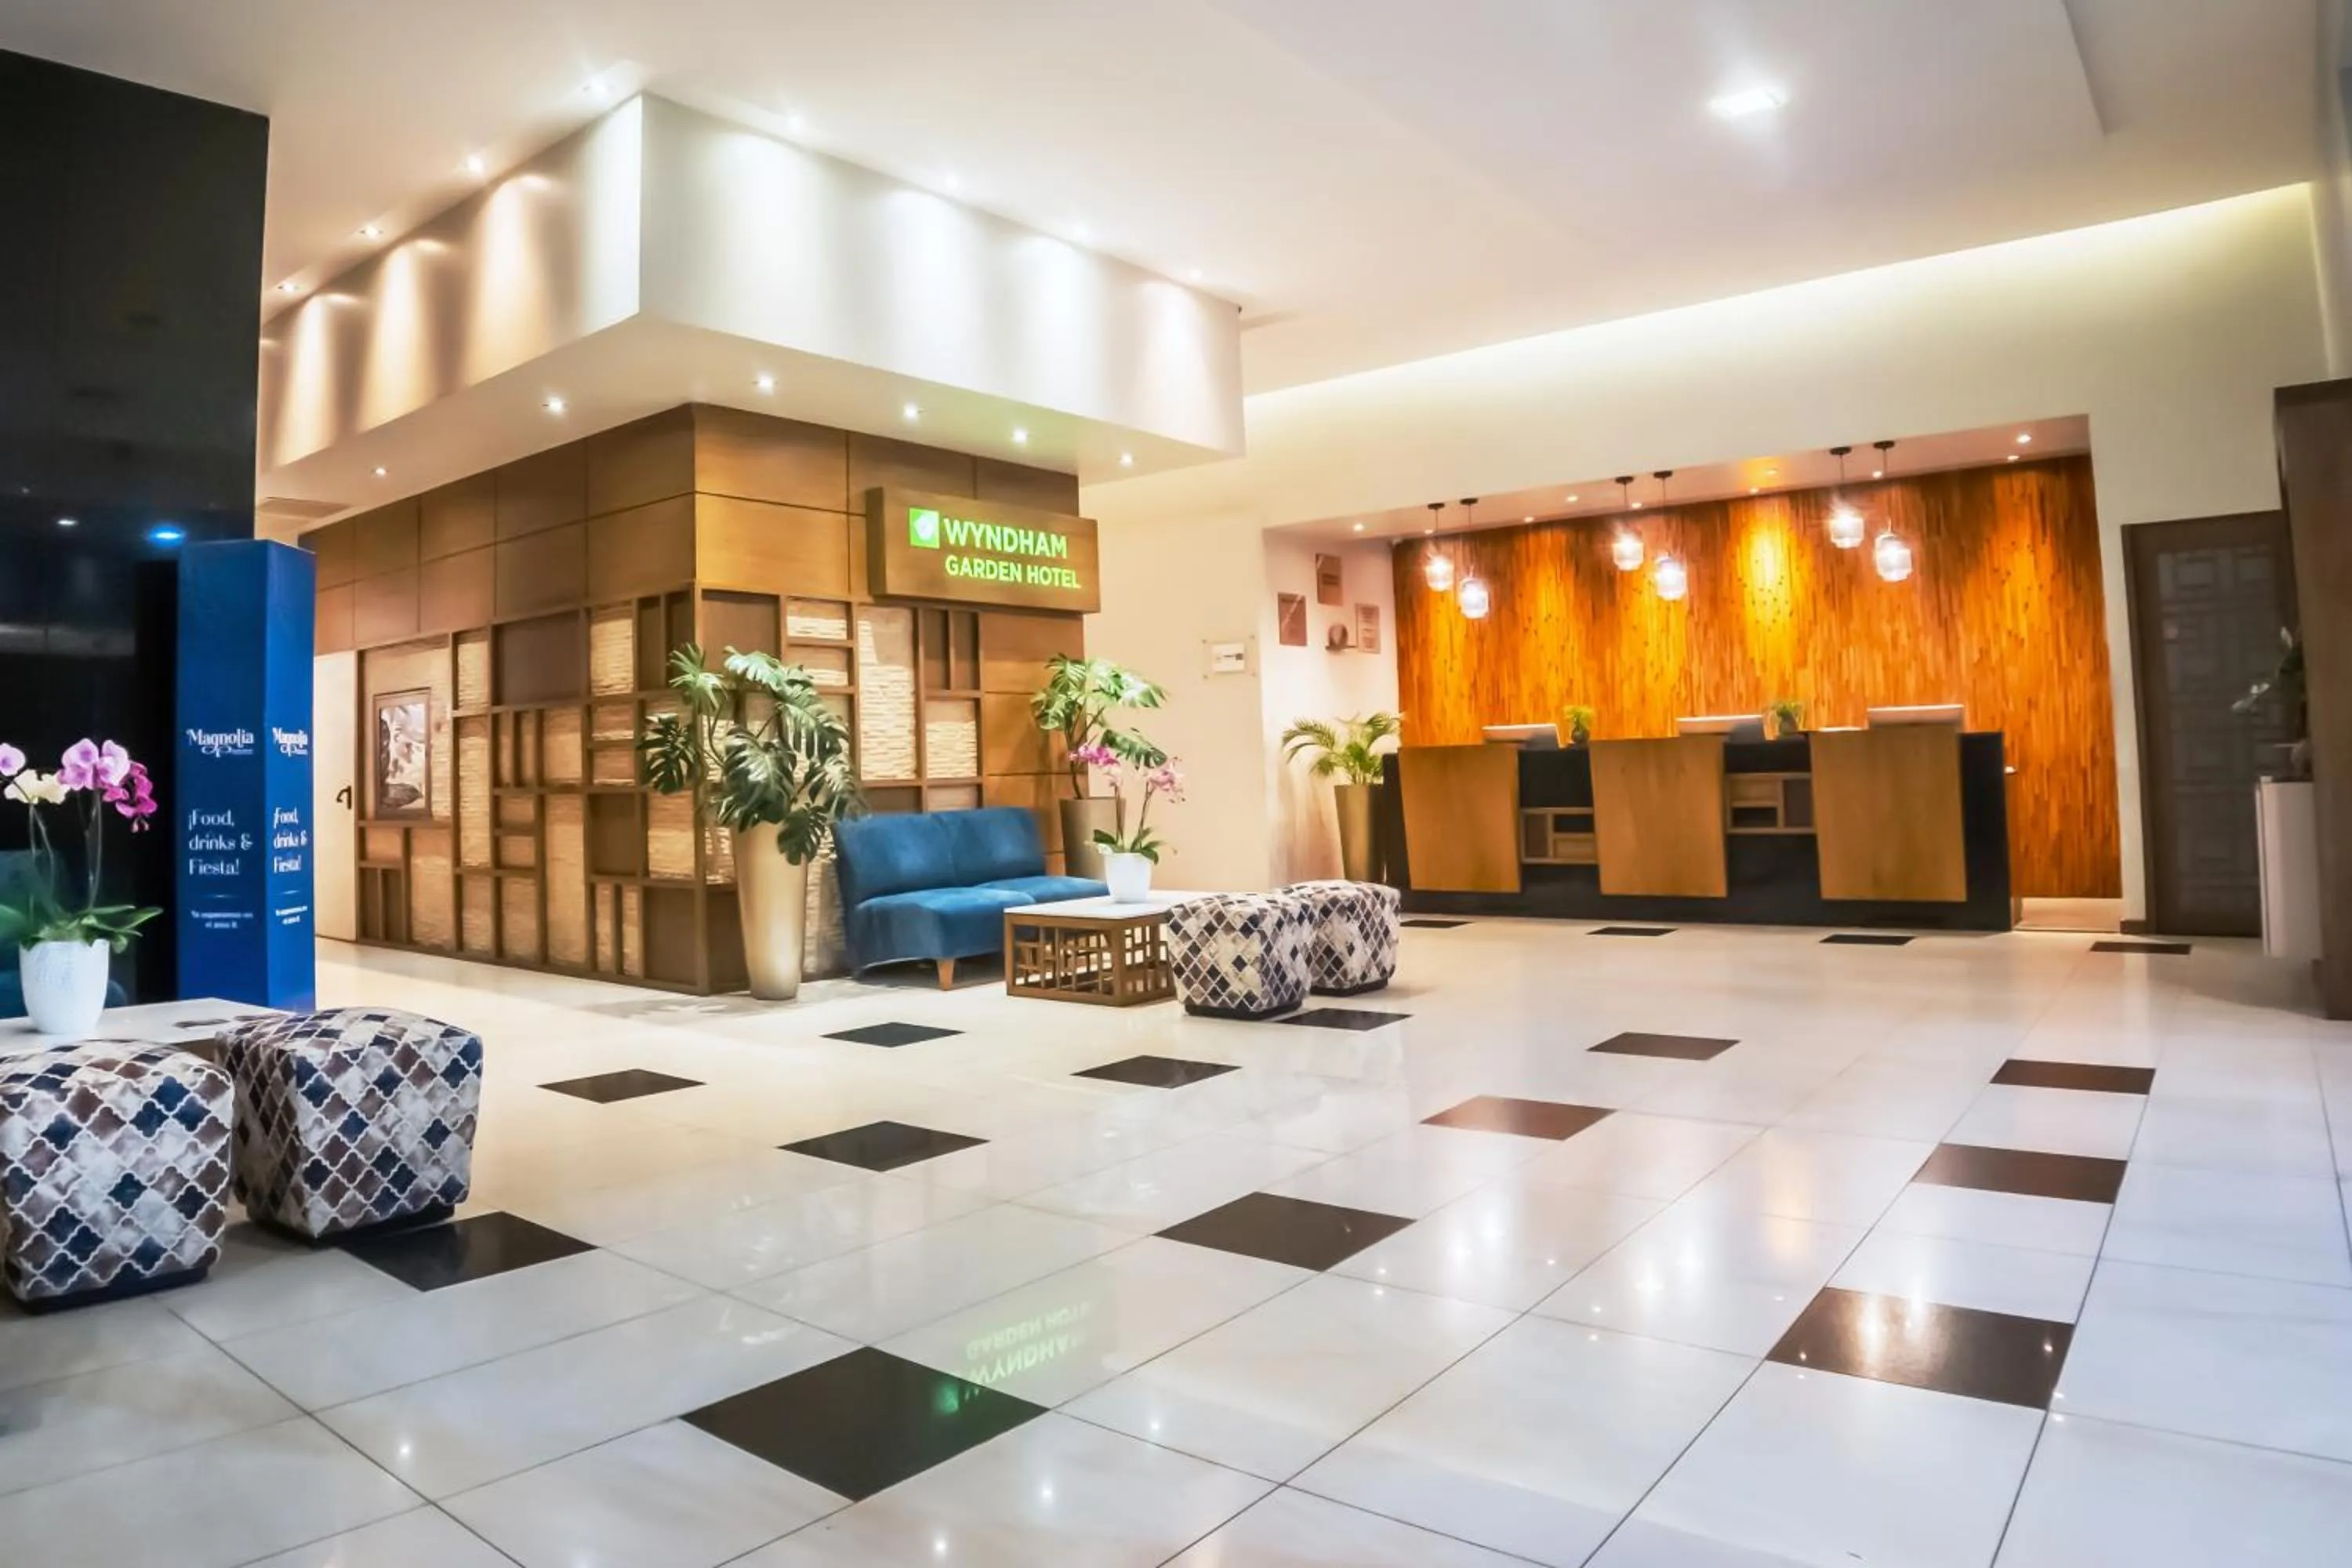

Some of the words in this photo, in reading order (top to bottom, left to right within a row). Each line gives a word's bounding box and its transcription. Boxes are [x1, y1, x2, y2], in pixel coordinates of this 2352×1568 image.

[943, 517, 1068, 559] WYNDHAM
[945, 554, 1022, 583] GARDEN
[1026, 564, 1081, 589] HOTEL
[186, 728, 255, 758] Magnolia
[188, 808, 235, 831] ¡Food,
[188, 833, 236, 851] drinks
[241, 833, 253, 851] &
[188, 858, 240, 877] Fiesta!
